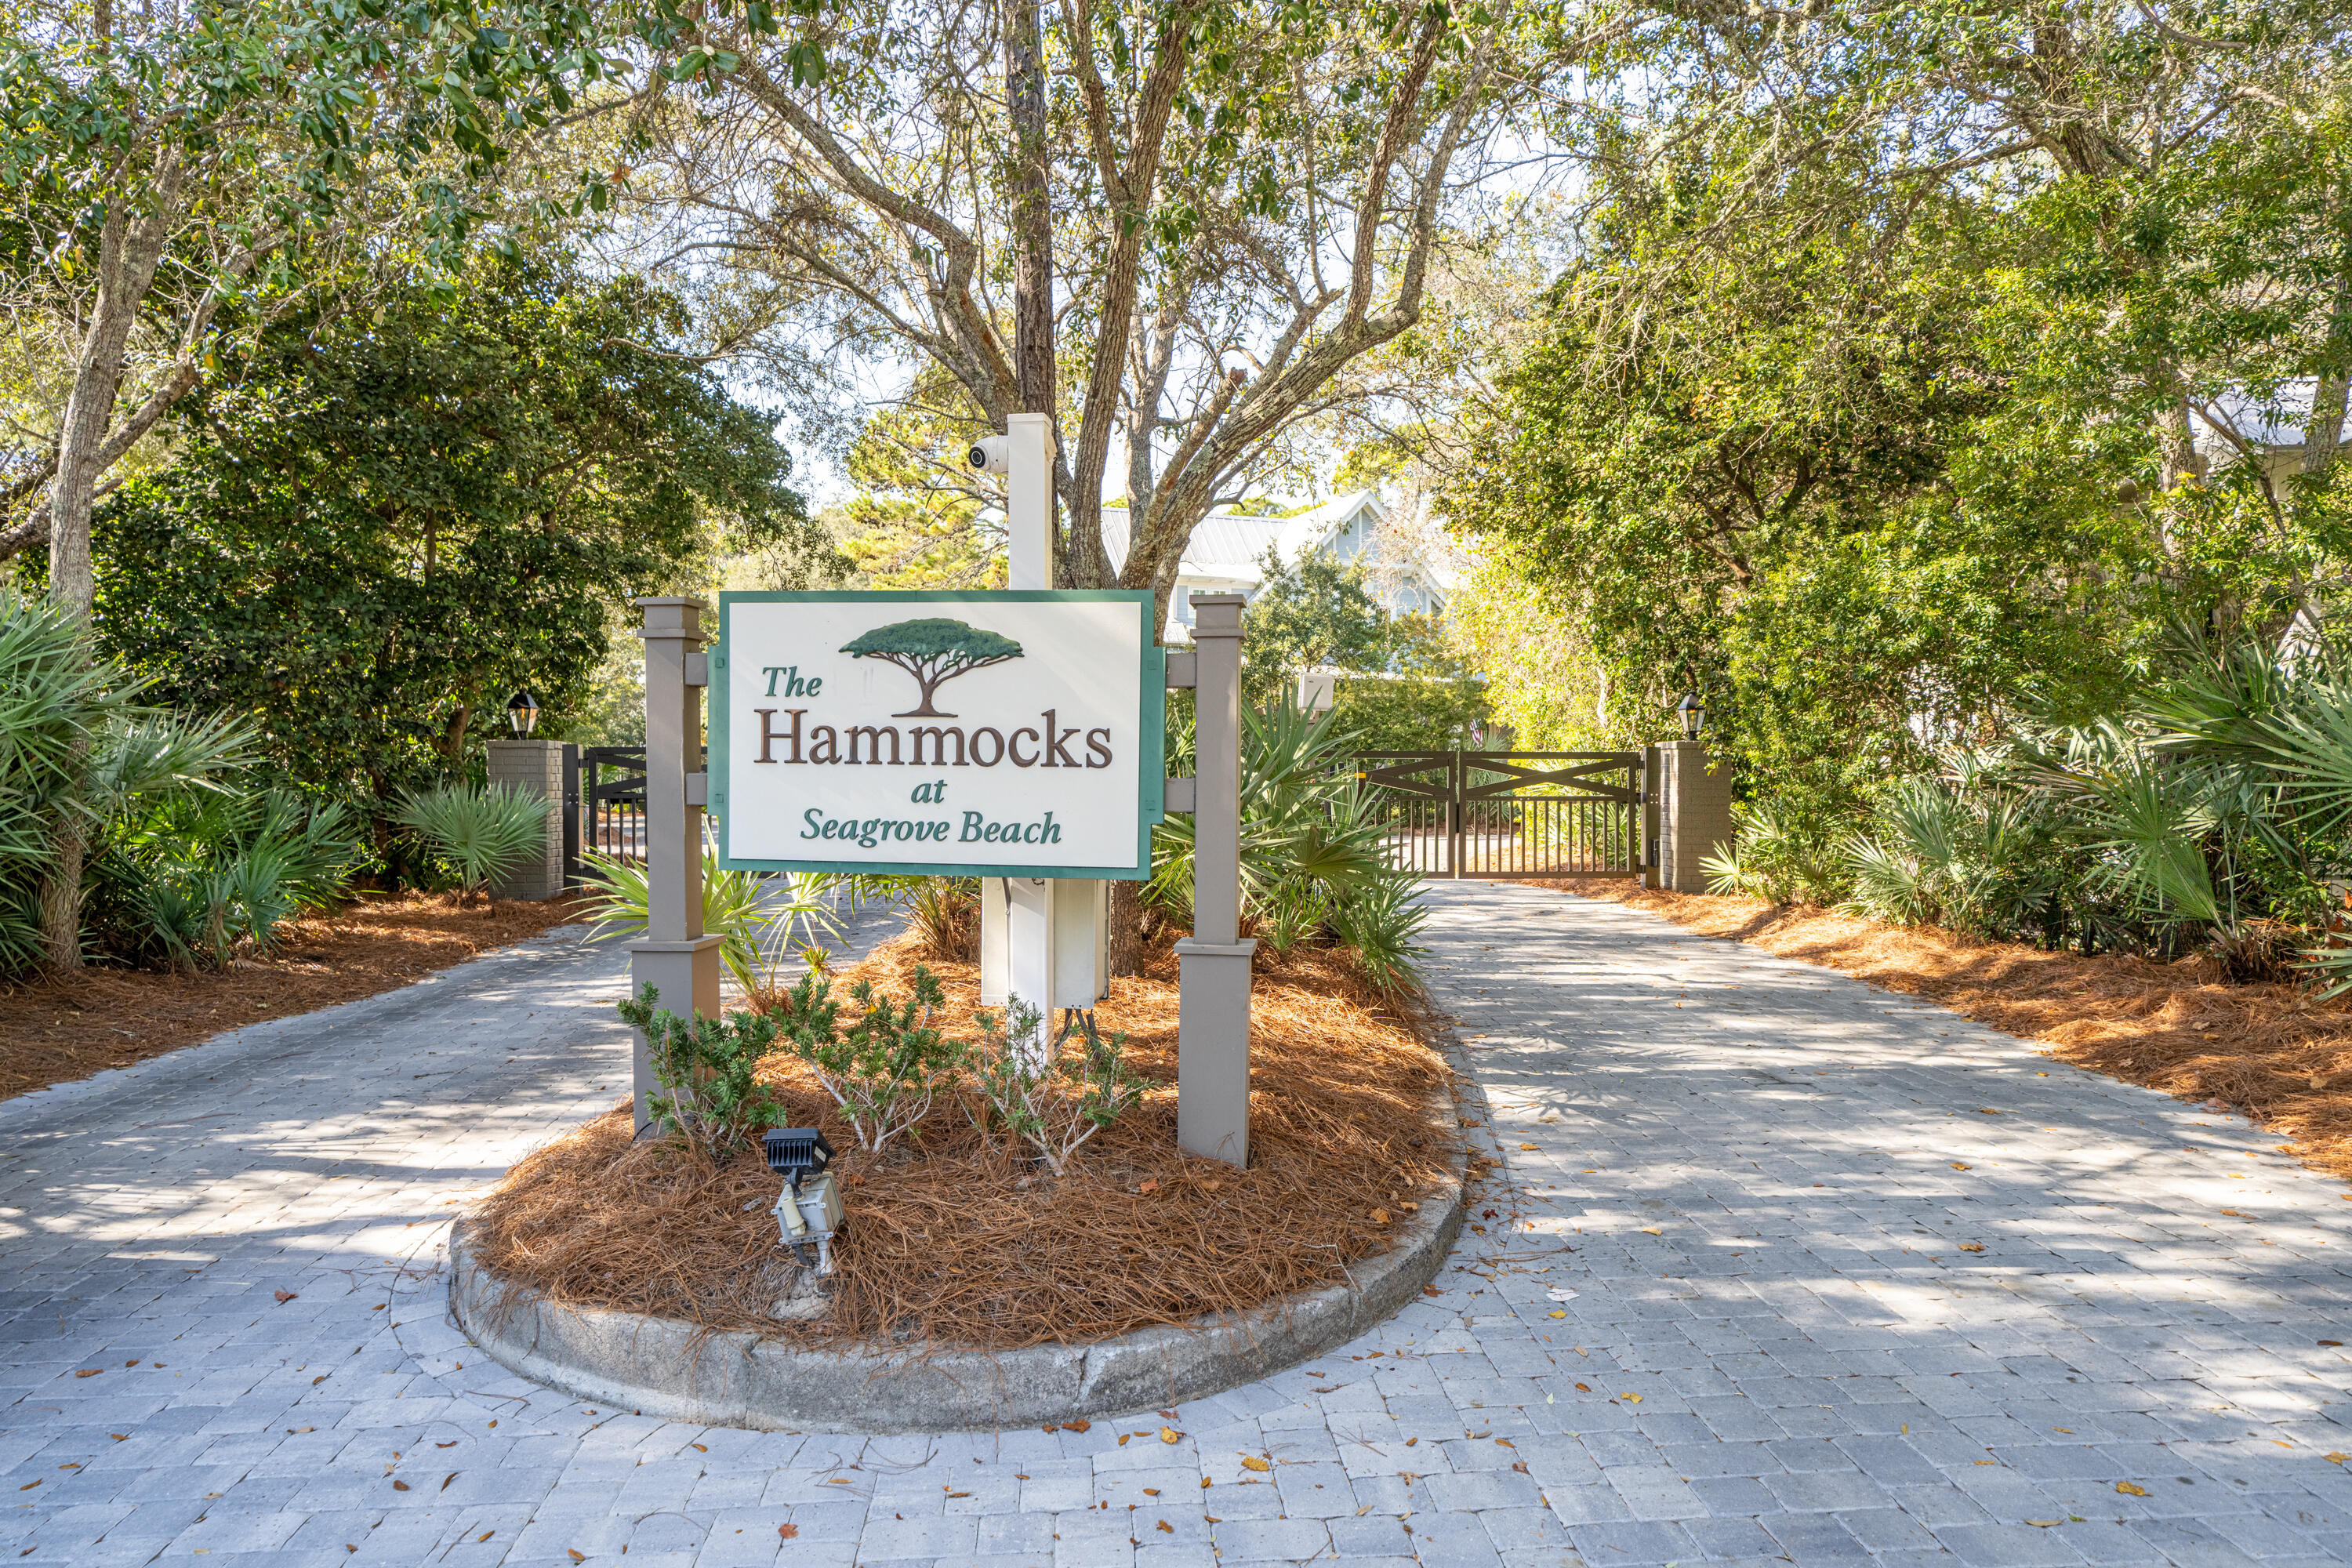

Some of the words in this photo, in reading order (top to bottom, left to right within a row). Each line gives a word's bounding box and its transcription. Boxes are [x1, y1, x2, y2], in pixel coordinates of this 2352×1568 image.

[763, 666, 822, 697] The
[753, 709, 1113, 768] Hammocks
[911, 779, 947, 804] at
[800, 808, 949, 848] Seagrove
[958, 811, 1061, 844] Beach
